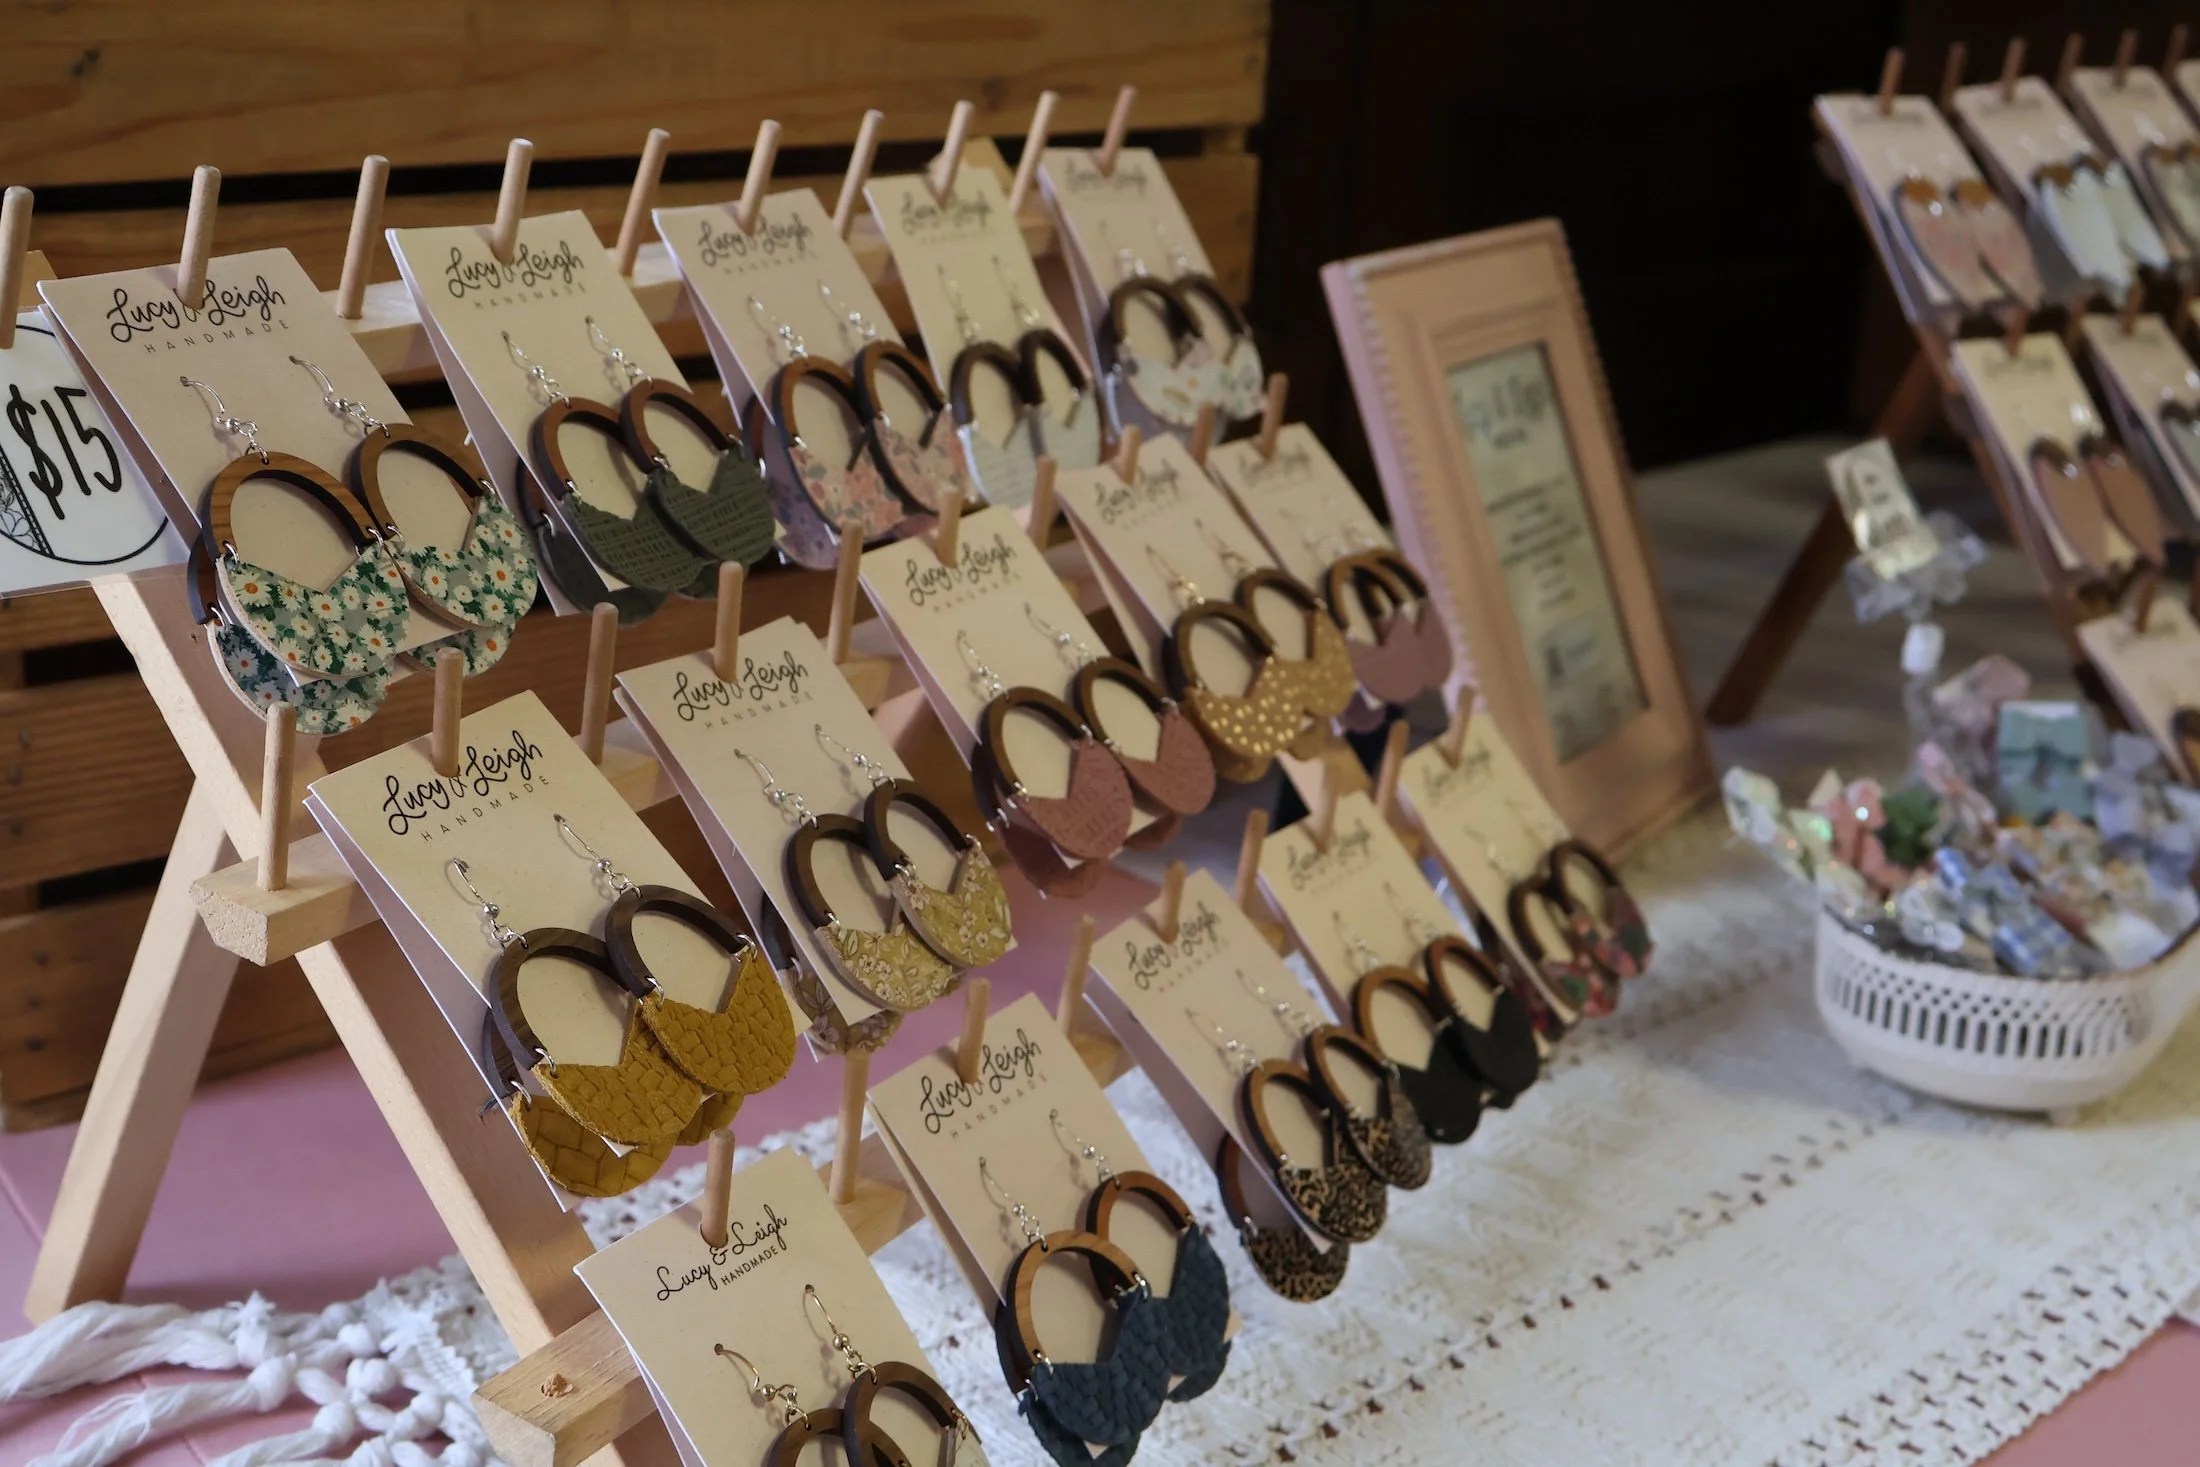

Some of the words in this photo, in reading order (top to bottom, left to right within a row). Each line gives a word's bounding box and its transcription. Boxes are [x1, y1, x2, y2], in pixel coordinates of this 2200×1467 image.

[445, 247, 501, 298] Lucy
[516, 240, 584, 287] Leigh
[106, 288, 181, 343] Lucy
[200, 275, 286, 326] Leigh
[144, 319, 289, 353] HANDMADE
[6, 384, 122, 520] $15
[673, 671, 730, 722] Lucy
[743, 650, 809, 701] Leigh
[383, 775, 450, 836] Lucy
[465, 730, 543, 796] Leigh
[421, 775, 550, 842] HANDMADE
[920, 1075, 972, 1135] Lucy
[982, 1028, 1042, 1094] Leigh
[656, 1266, 718, 1301] Lucy
[709, 1245, 729, 1266] &
[731, 1204, 788, 1255] Leigh
[720, 1245, 779, 1286] HANDMADE
